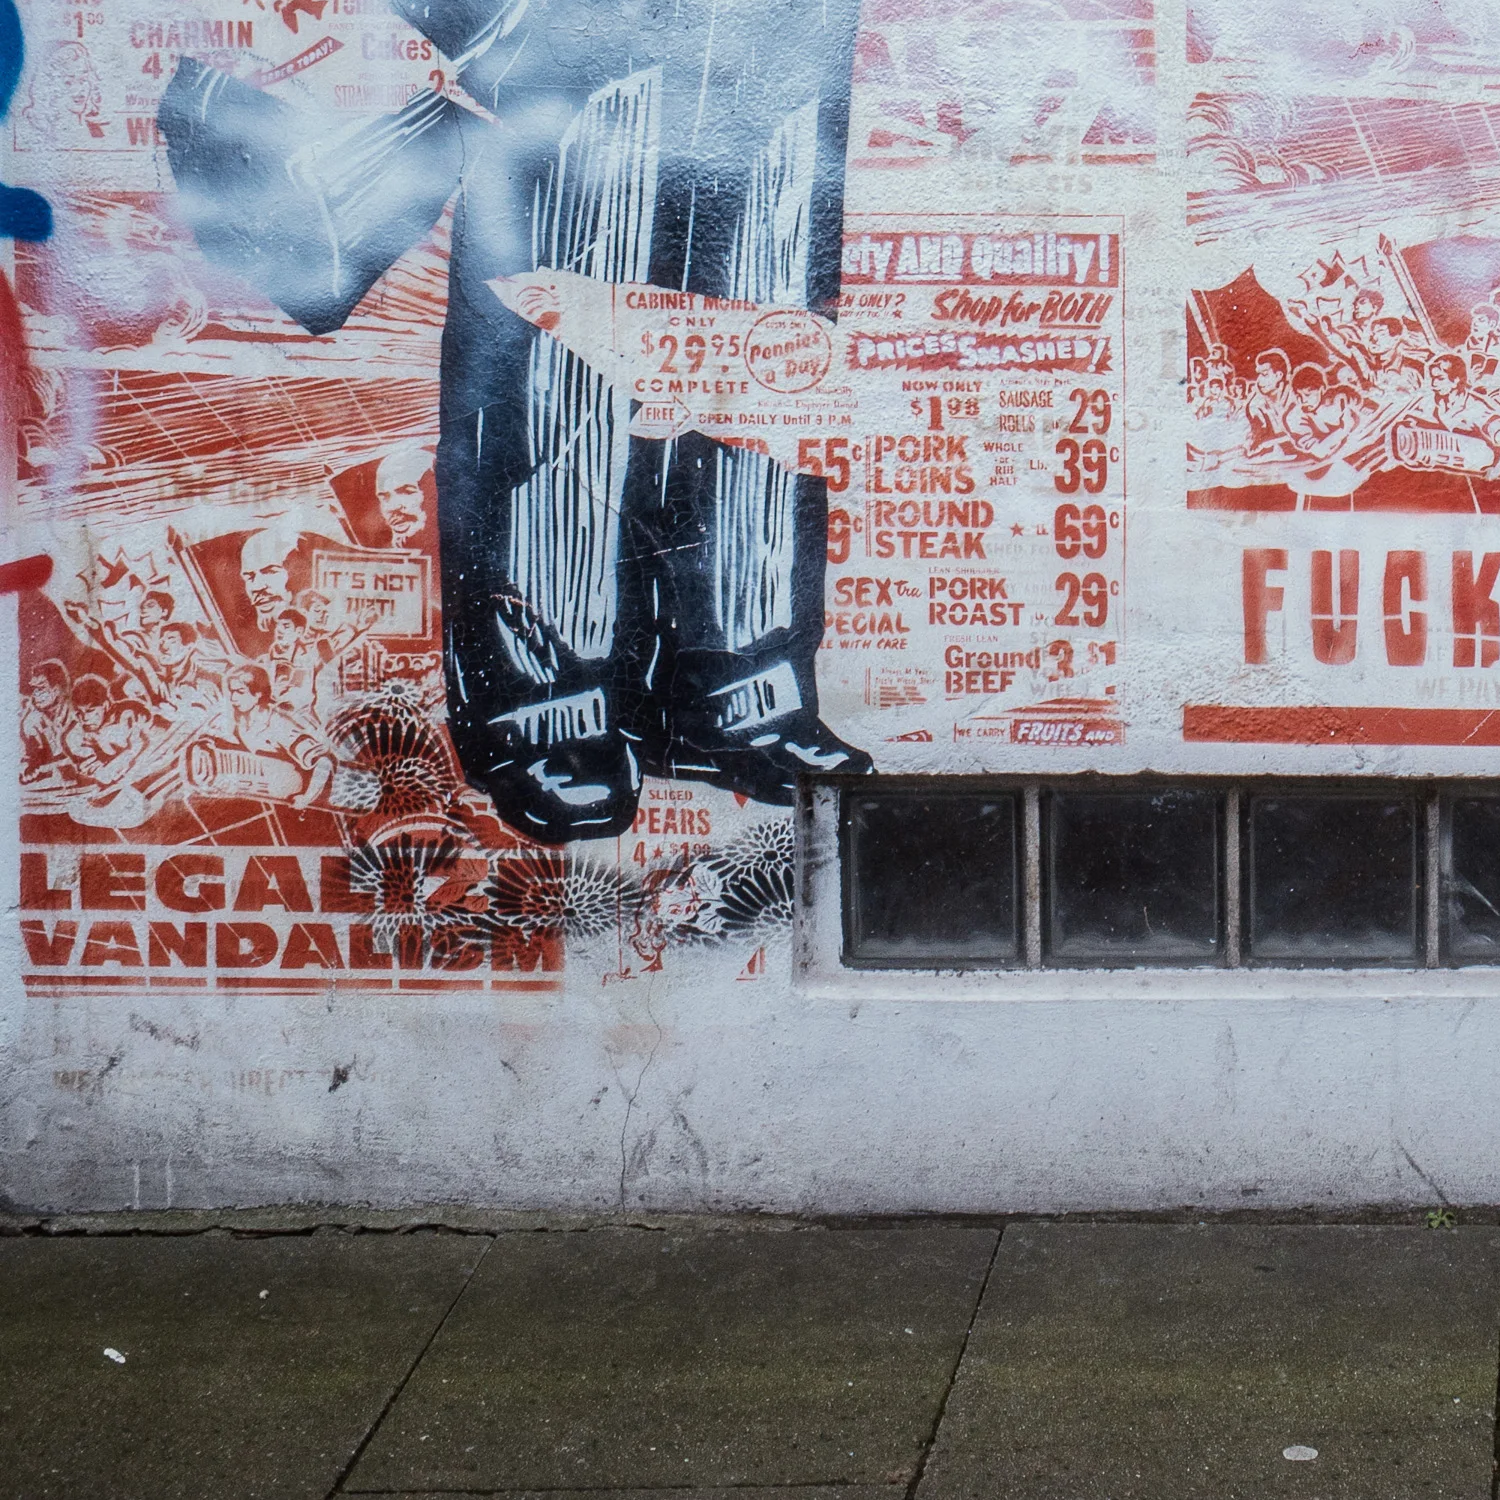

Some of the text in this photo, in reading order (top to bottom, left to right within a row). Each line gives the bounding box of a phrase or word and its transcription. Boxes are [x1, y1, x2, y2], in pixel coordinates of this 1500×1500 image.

[130, 20, 254, 49] CHARMIN
[898, 235, 964, 281] AND
[970, 233, 1111, 284] Quality!
[626, 291, 697, 311] CABINET
[930, 288, 1114, 328] Shop for BOTH
[670, 316, 717, 329] ONLY
[856, 336, 1106, 373] PRICES SMASHED!
[634, 378, 750, 395] COMPLETE
[902, 380, 982, 393] NOW ONLY
[999, 389, 1054, 408] SAUSAGE
[646, 406, 676, 421] FREE
[698, 412, 734, 425] OPEN
[738, 412, 777, 425] DAILY
[783, 412, 811, 425] Until
[999, 413, 1037, 433] ROLLS
[873, 435, 970, 463] PORK
[983, 440, 1025, 453] WHOLE
[873, 465, 1015, 495] LOINS RIB
[873, 499, 996, 529] ROUND
[874, 531, 988, 560] STEAK
[322, 570, 420, 593] IT'S NOT
[928, 576, 1009, 601] PORK
[823, 610, 911, 637] PECIAL
[928, 602, 1026, 627] ROAST
[839, 638, 874, 651] WITH
[876, 637, 909, 650] CARE
[976, 634, 999, 643] LEAN
[944, 644, 1042, 670] Ground
[944, 670, 1017, 694] BEEF
[957, 726, 972, 738] WE
[976, 726, 1007, 738] CARRY
[1016, 721, 1083, 742] FRUITS
[649, 789, 693, 801] SLICED
[632, 807, 712, 836] PEARS
[19, 920, 566, 973] VANDALISM
